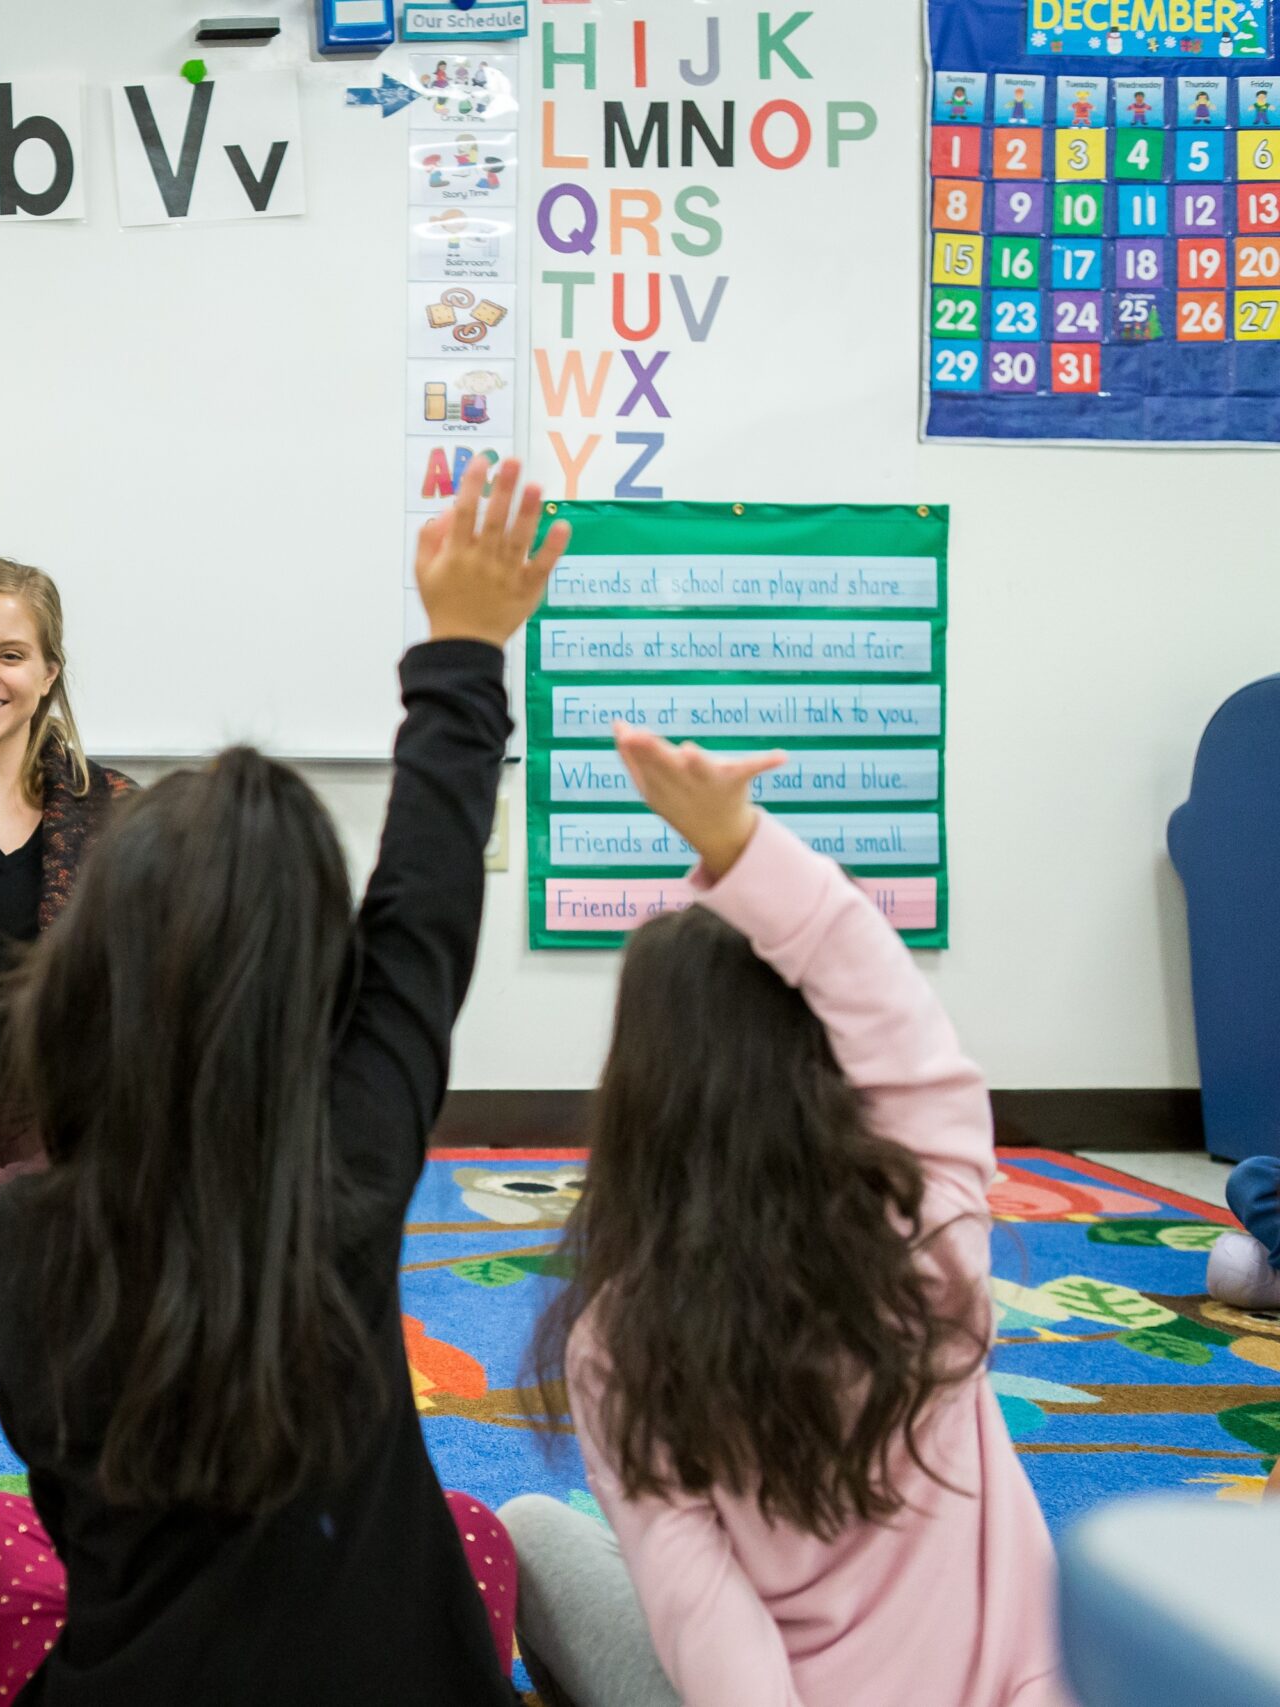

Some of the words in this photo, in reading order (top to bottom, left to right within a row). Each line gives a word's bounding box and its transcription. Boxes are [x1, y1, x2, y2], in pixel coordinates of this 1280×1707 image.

[413, 13, 441, 28] Our
[447, 12, 521, 28] Schedule
[1032, 0, 1239, 33] DECEMBER
[1184, 80, 1220, 90] Thursday
[1250, 80, 1273, 89] Friday
[123, 81, 289, 218] Vv
[952, 135, 960, 168] 1
[1006, 138, 1028, 170] 2
[1068, 139, 1089, 170] 3
[1126, 139, 1150, 170] 4
[1188, 141, 1209, 172] 5
[1253, 139, 1274, 169] 6
[946, 190, 967, 221] 8
[1009, 191, 1032, 223] 9
[1063, 194, 1096, 226] 10
[1132, 195, 1156, 226] 11
[1184, 195, 1216, 227] 12
[1249, 193, 1279, 224] 13
[943, 244, 974, 275] 15
[1001, 248, 1034, 280] 16
[1063, 249, 1095, 281] 17
[1126, 249, 1158, 281] 18
[1189, 248, 1220, 279] 19
[1239, 246, 1280, 278] 20
[935, 300, 977, 332] 22
[996, 302, 1037, 333] 23
[1055, 302, 1099, 333] 24
[1119, 300, 1149, 322] 25
[1182, 302, 1222, 333] 26
[1240, 300, 1279, 332] 27
[935, 349, 978, 382] 29
[992, 351, 1036, 384] 30
[1058, 353, 1092, 384] 31
[554, 566, 631, 595] Friends
[641, 567, 659, 595] at
[670, 567, 724, 595] school
[732, 576, 761, 594] can
[769, 569, 803, 601] play
[808, 571, 838, 595] and
[550, 630, 633, 659] Friends
[643, 633, 663, 658] at
[670, 632, 722, 659] school
[730, 642, 759, 659] are
[772, 631, 813, 659] kind
[822, 632, 855, 659] and
[864, 631, 905, 660] fair.
[562, 697, 646, 726] Friends
[657, 696, 678, 724] at
[690, 696, 748, 724] school
[759, 697, 797, 724] will
[803, 696, 843, 724] talk
[851, 698, 869, 723] to
[878, 706, 919, 730] you.
[558, 761, 627, 789] When
[772, 762, 803, 790] sad
[812, 761, 847, 789] and
[860, 761, 908, 790] blue.
[559, 825, 642, 853] Friends
[651, 825, 671, 853] at
[811, 826, 845, 853] and
[855, 825, 907, 853] small.
[557, 889, 638, 918] Friends
[646, 889, 667, 917] at
